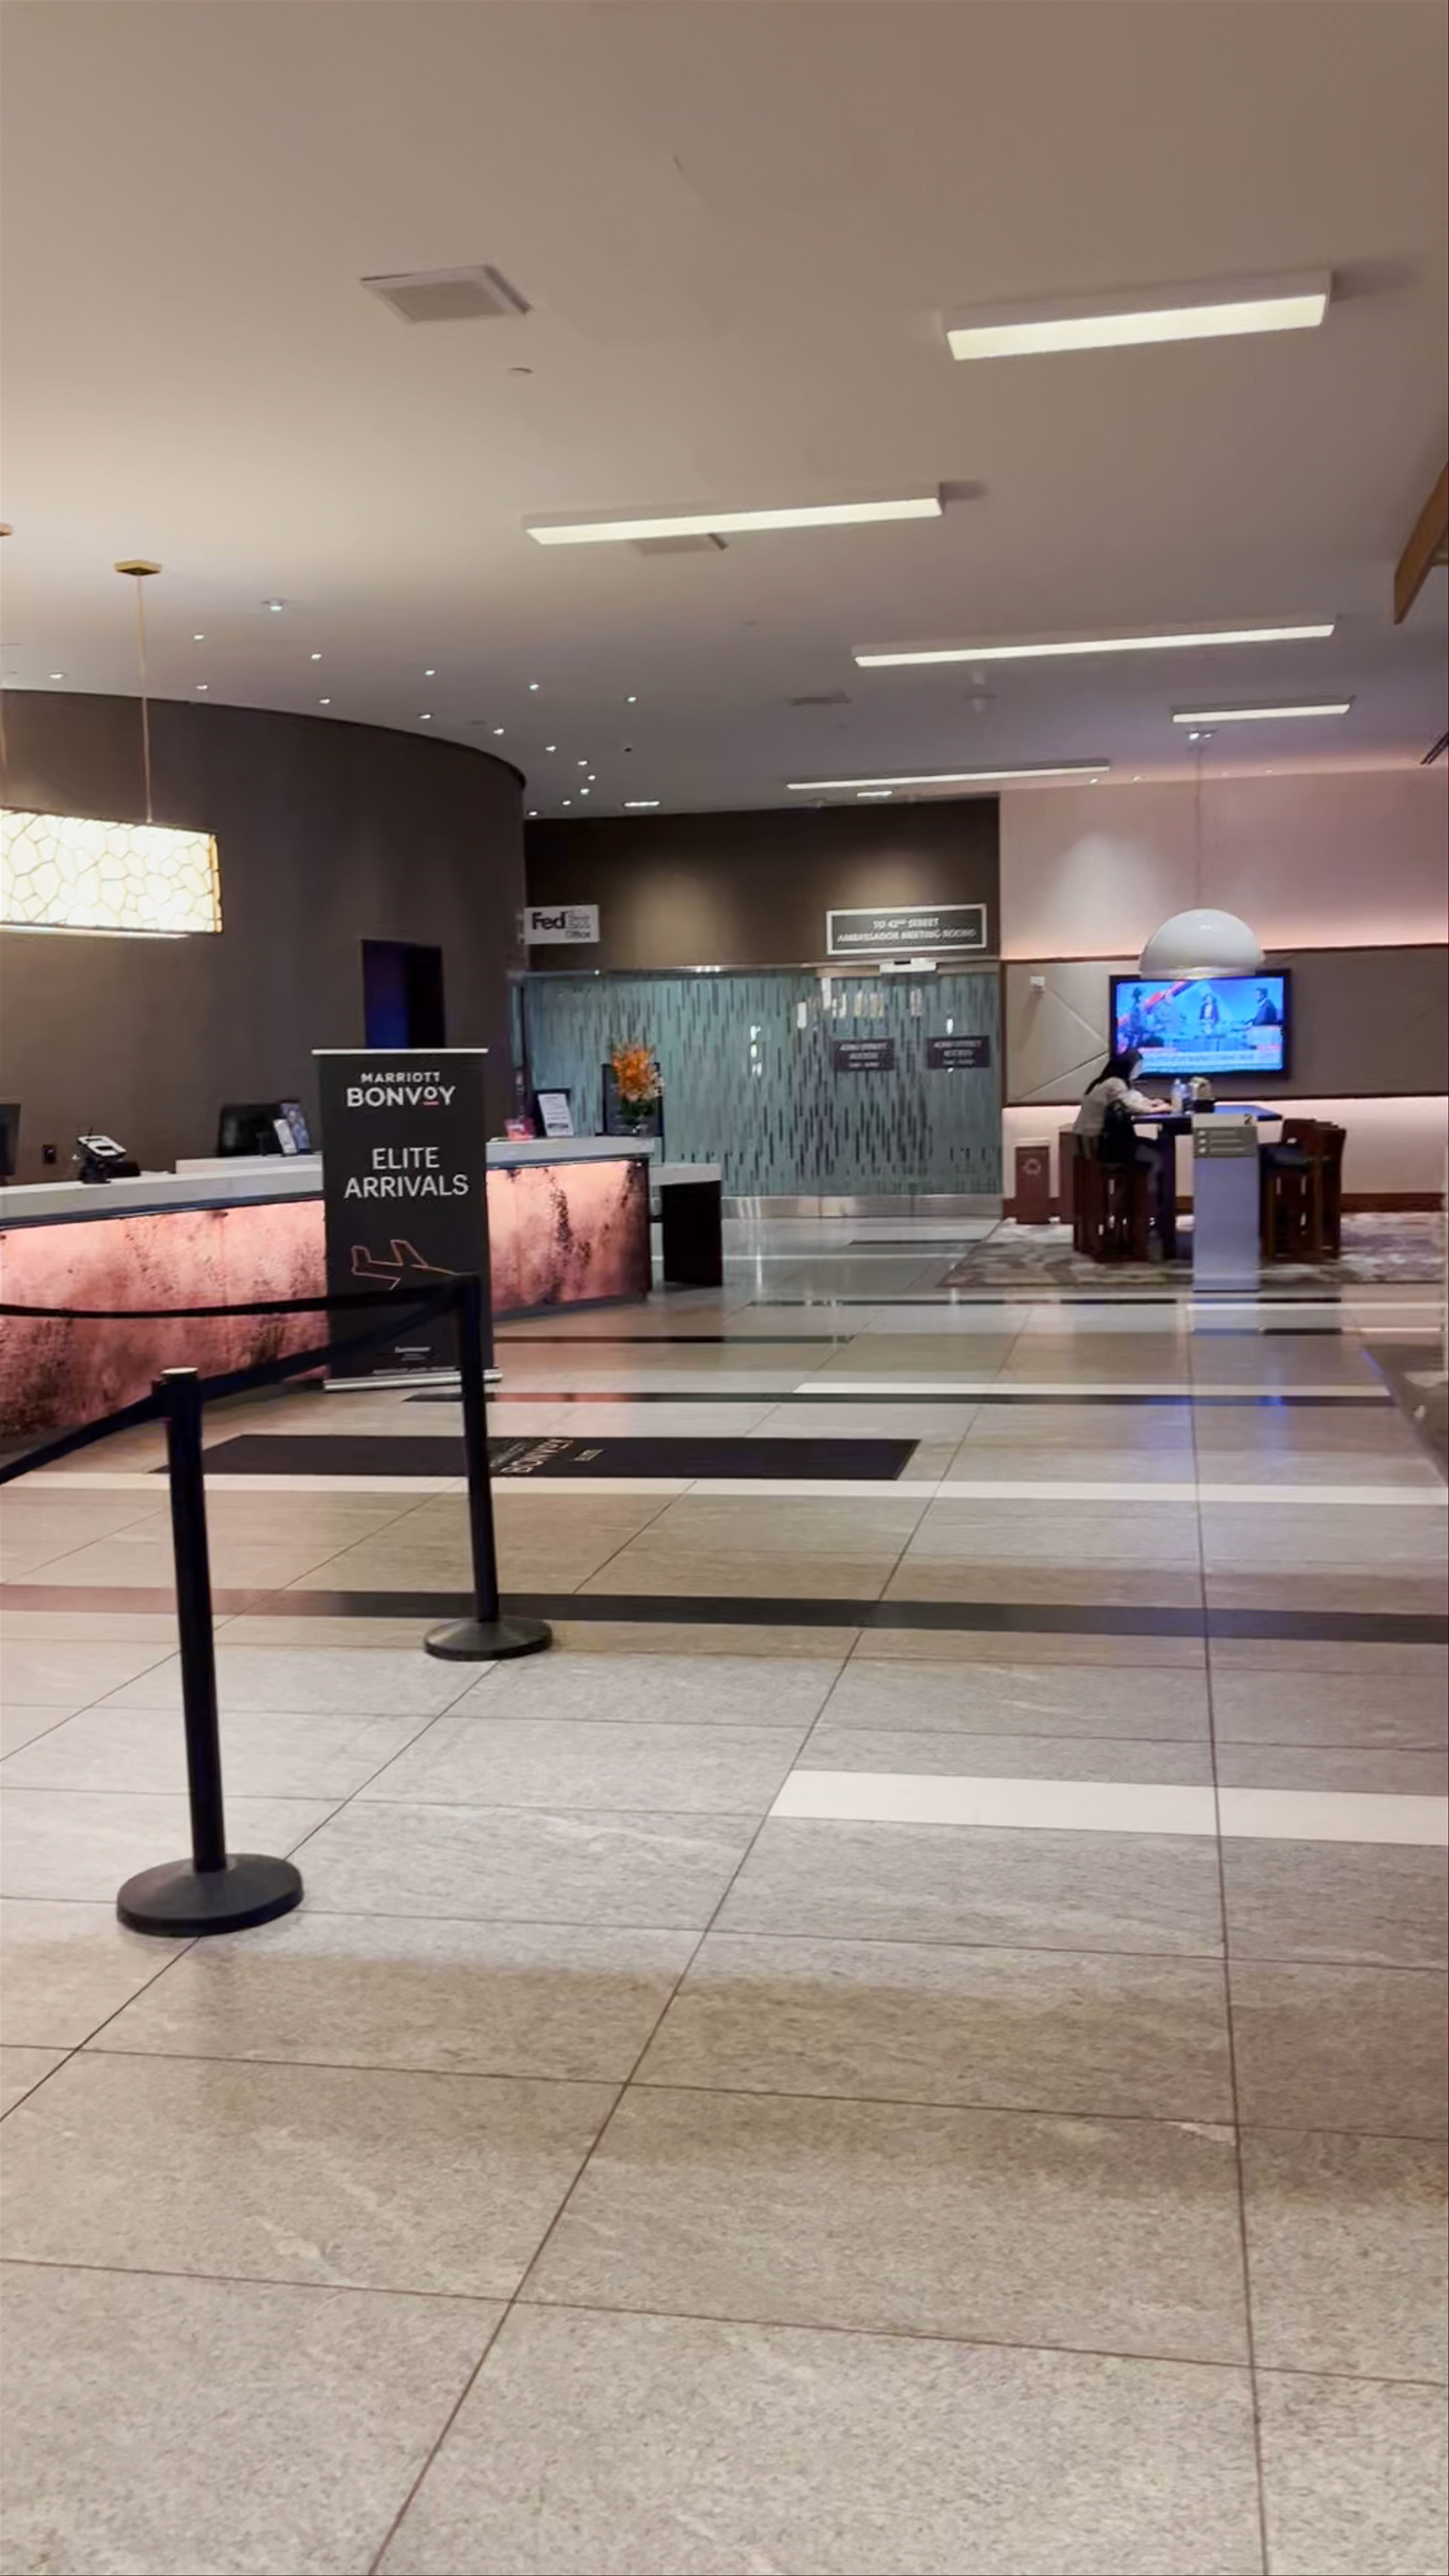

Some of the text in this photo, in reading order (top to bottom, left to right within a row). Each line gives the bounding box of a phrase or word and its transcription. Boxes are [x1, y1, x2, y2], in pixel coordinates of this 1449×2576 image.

[873, 921, 886, 929] TO
[908, 918, 939, 928] STREET
[837, 932, 899, 942] AMBASSADOR
[901, 930, 941, 939] MEETING
[361, 1072, 440, 1083] MARRIOTT
[346, 1086, 455, 1107] BONVOY
[372, 1147, 440, 1169] ELITE
[344, 1174, 469, 1198] ARRIVALS
